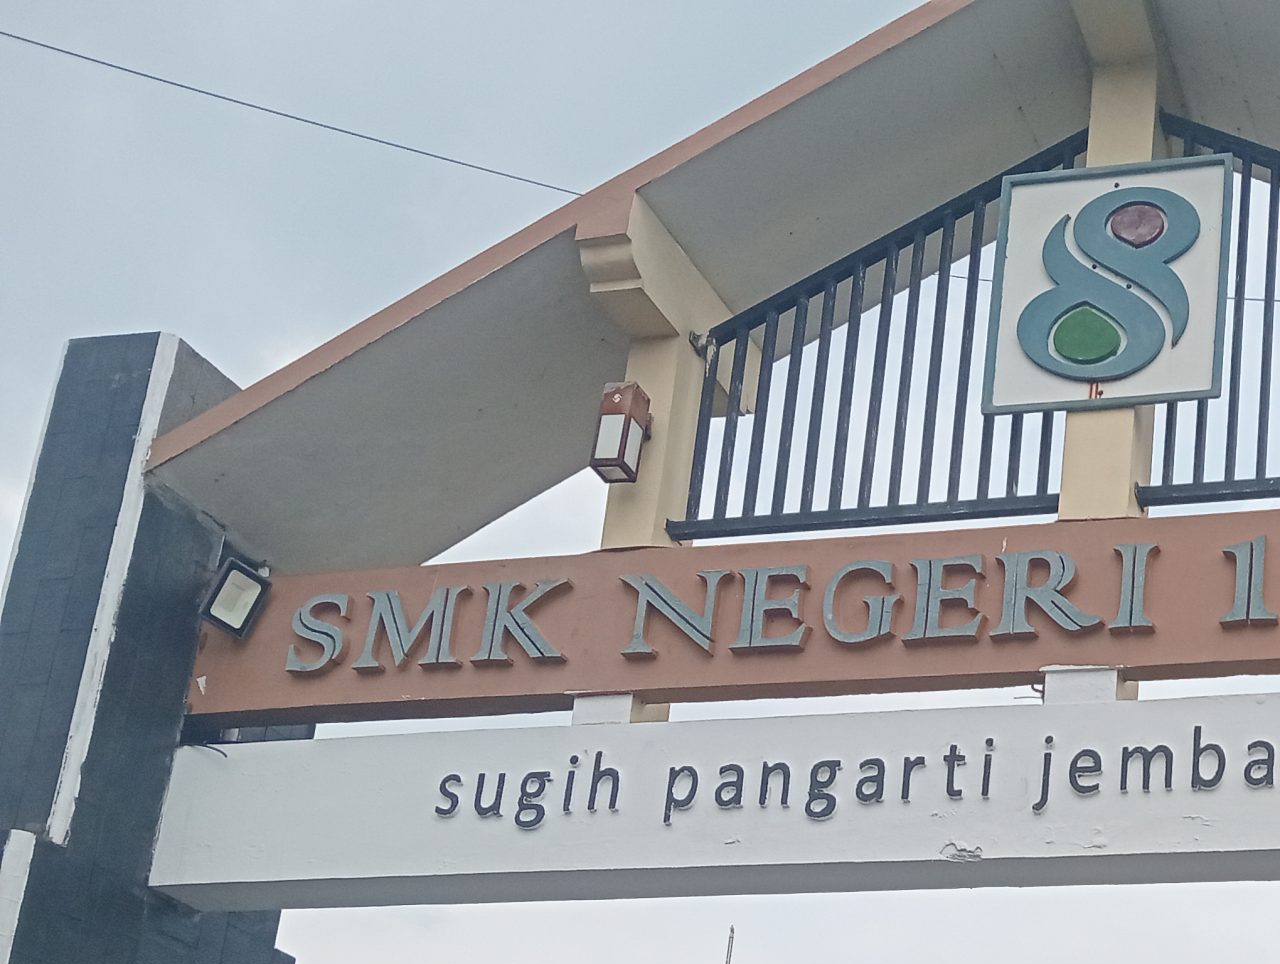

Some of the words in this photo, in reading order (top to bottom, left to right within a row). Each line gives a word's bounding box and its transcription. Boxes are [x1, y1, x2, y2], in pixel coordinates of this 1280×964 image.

[285, 577, 574, 676] SMK
[620, 542, 1158, 660] NEGERI
[1219, 533, 1278, 630] 1
[434, 749, 620, 829] sugih
[664, 736, 994, 824] pangarti
